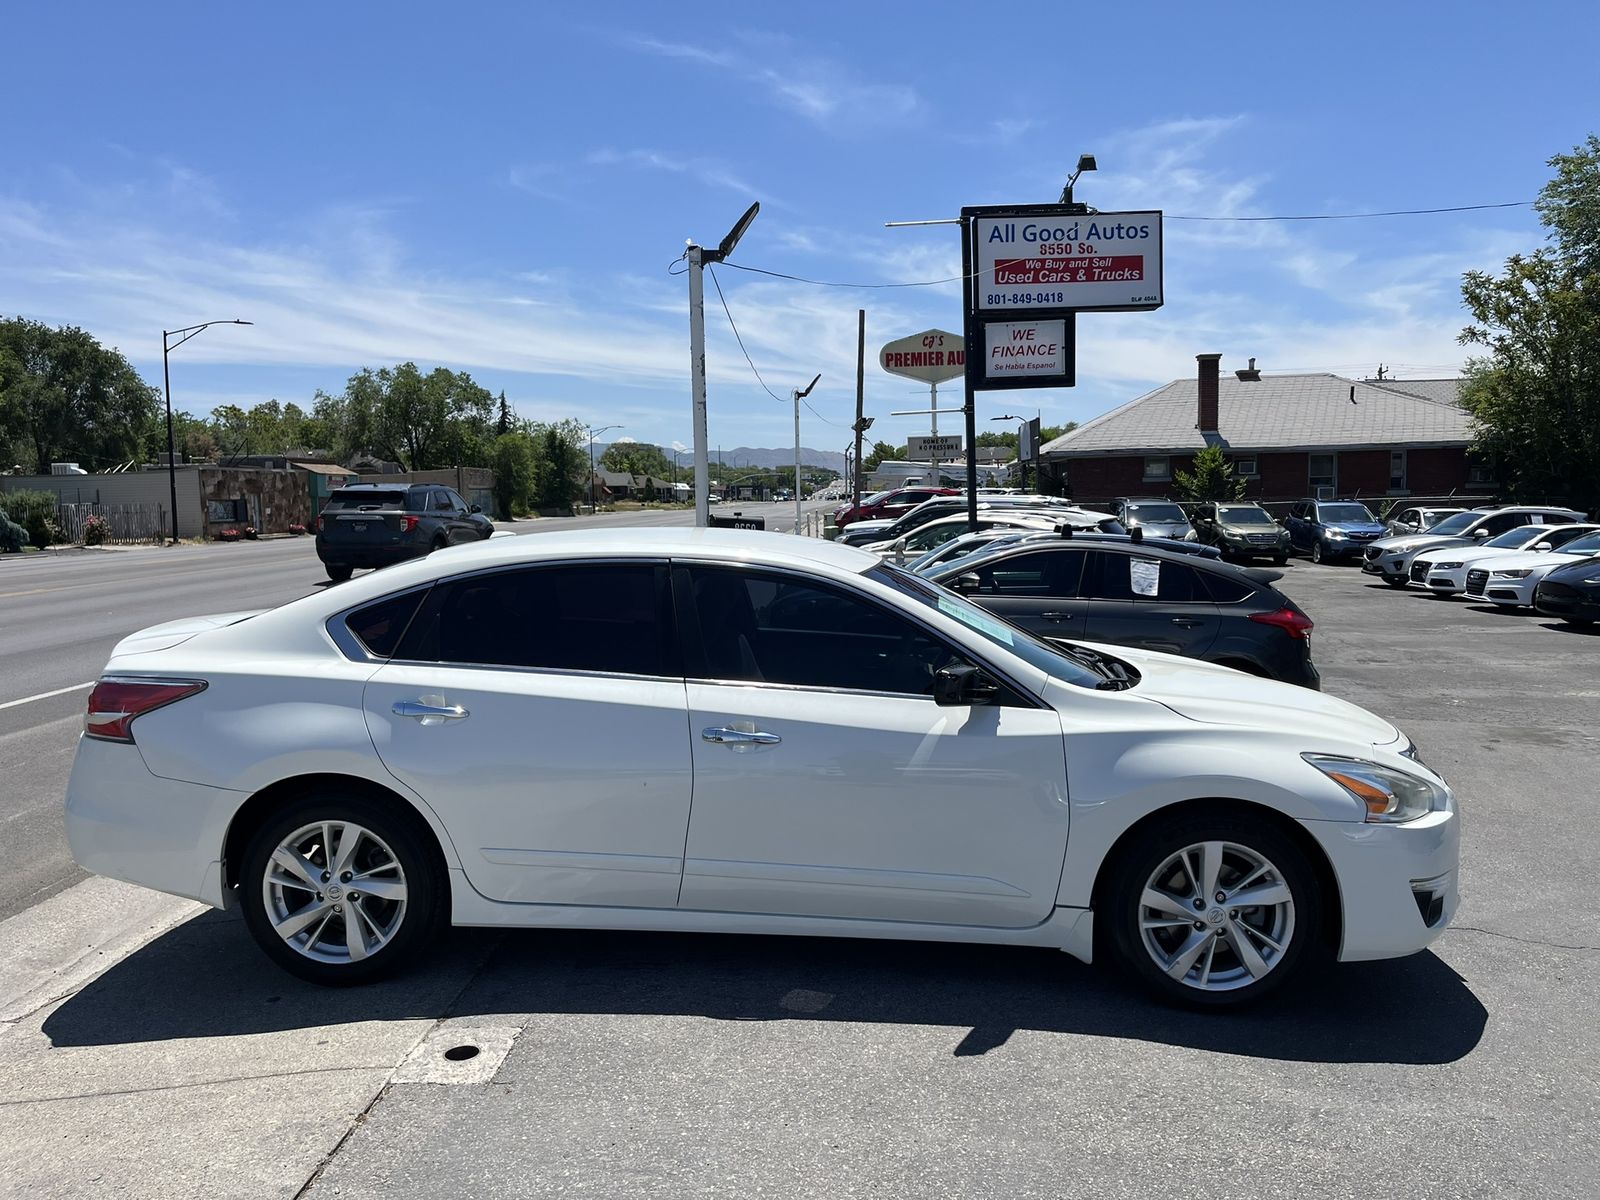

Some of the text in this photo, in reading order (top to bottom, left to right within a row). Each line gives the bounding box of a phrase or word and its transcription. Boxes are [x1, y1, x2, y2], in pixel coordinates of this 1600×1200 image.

[989, 222, 1149, 243] All Good Autos
[1040, 242, 1097, 255] 8550 So.
[1025, 258, 1112, 270] We Buy and Sell
[998, 268, 1140, 283] Used Cars & Trucks
[987, 292, 1064, 305] 801-849-0418
[1012, 329, 1035, 341] WE
[992, 344, 1057, 357] FINANCE
[885, 351, 944, 367] PREMIER
[1027, 361, 1056, 369] Espanol
